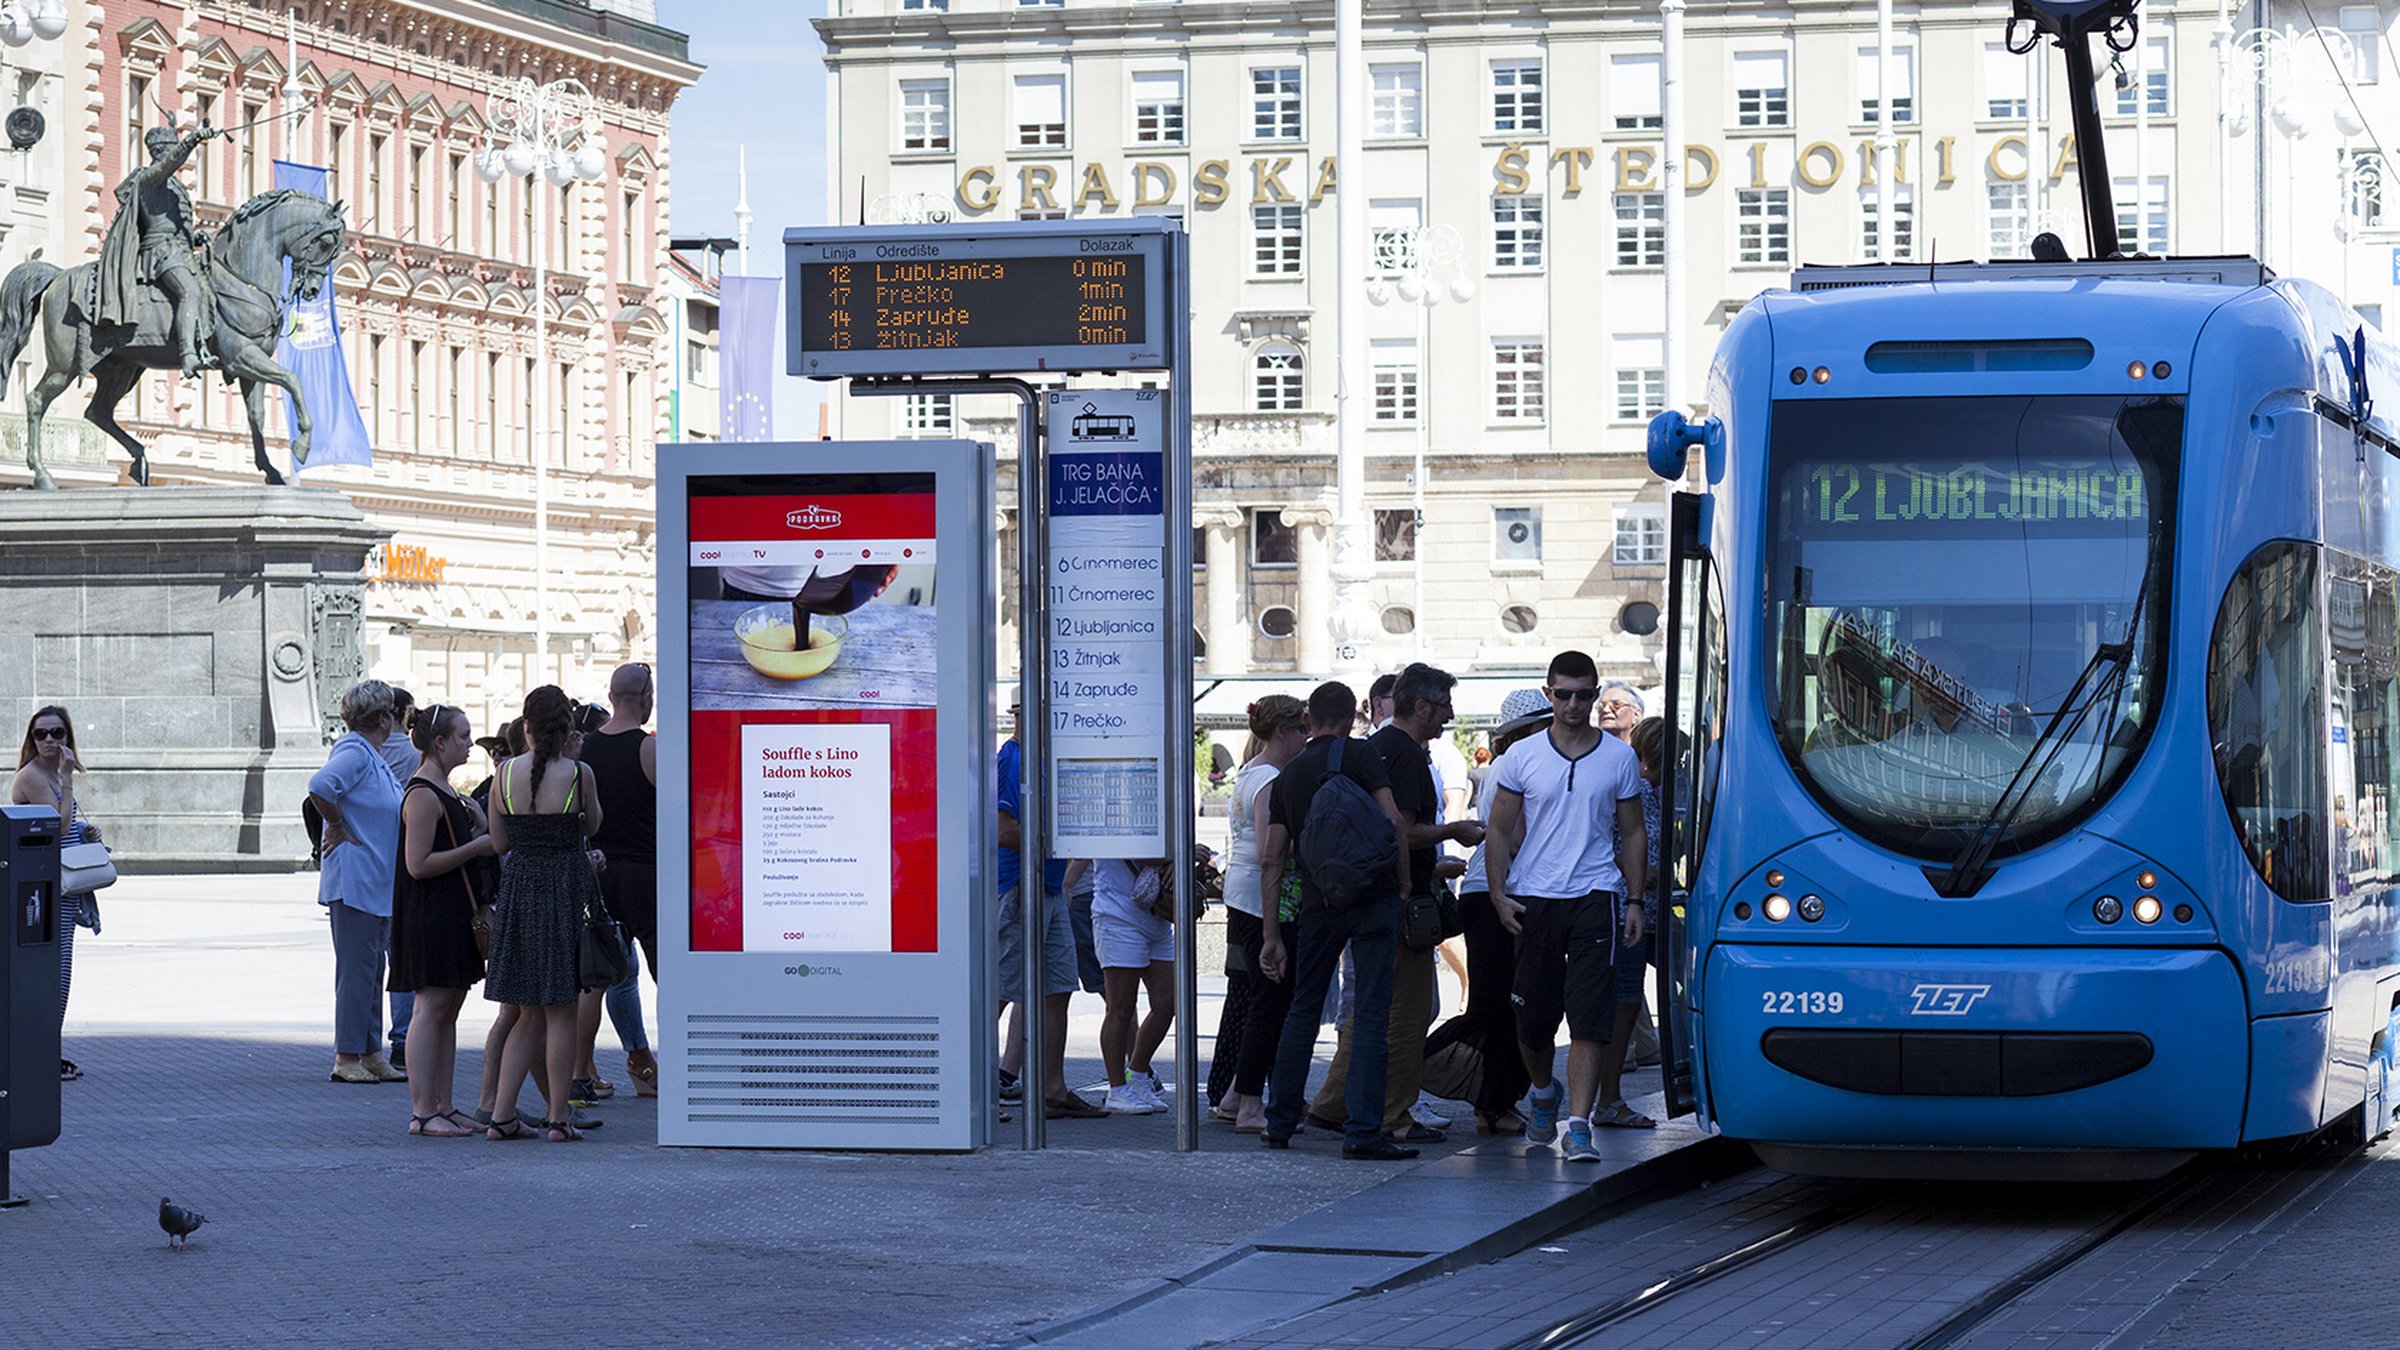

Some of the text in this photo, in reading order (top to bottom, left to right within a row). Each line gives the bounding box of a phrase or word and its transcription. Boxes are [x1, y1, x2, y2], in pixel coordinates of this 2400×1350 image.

[959, 156, 1337, 210] GRADSKA
[822, 239, 1135, 261] Linija Odredište Dolazak
[828, 258, 1126, 283] 12 Ljubljanica 0 min
[828, 287, 851, 305] 17
[876, 285, 953, 304] Prečko
[828, 309, 851, 327] 14
[828, 332, 851, 349] 13
[876, 329, 959, 348] Žitnjak
[1062, 463, 1144, 481] TRG BANA
[1055, 481, 1152, 505] J. JELAČIĆA
[1811, 464, 2143, 521] 12 LJUBLJANICA
[386, 543, 448, 583] Müller
[1058, 557, 1070, 573] 6
[1051, 585, 1155, 604] 11 Črnomerec
[1056, 618, 1155, 636] 12 Ljubljanica
[1053, 648, 1121, 668] 13 Žitnjak
[1053, 681, 1070, 698] 14
[1053, 712, 1123, 730] 17 Prečko
[762, 746, 859, 760] Souffle s Lino
[762, 765, 852, 778] ladom kokos
[763, 789, 796, 800] Sastojci
[784, 966, 843, 976] GO DIGITAL
[2264, 960, 2312, 995] 22139
[1762, 983, 1992, 1016] 22139 ZET
